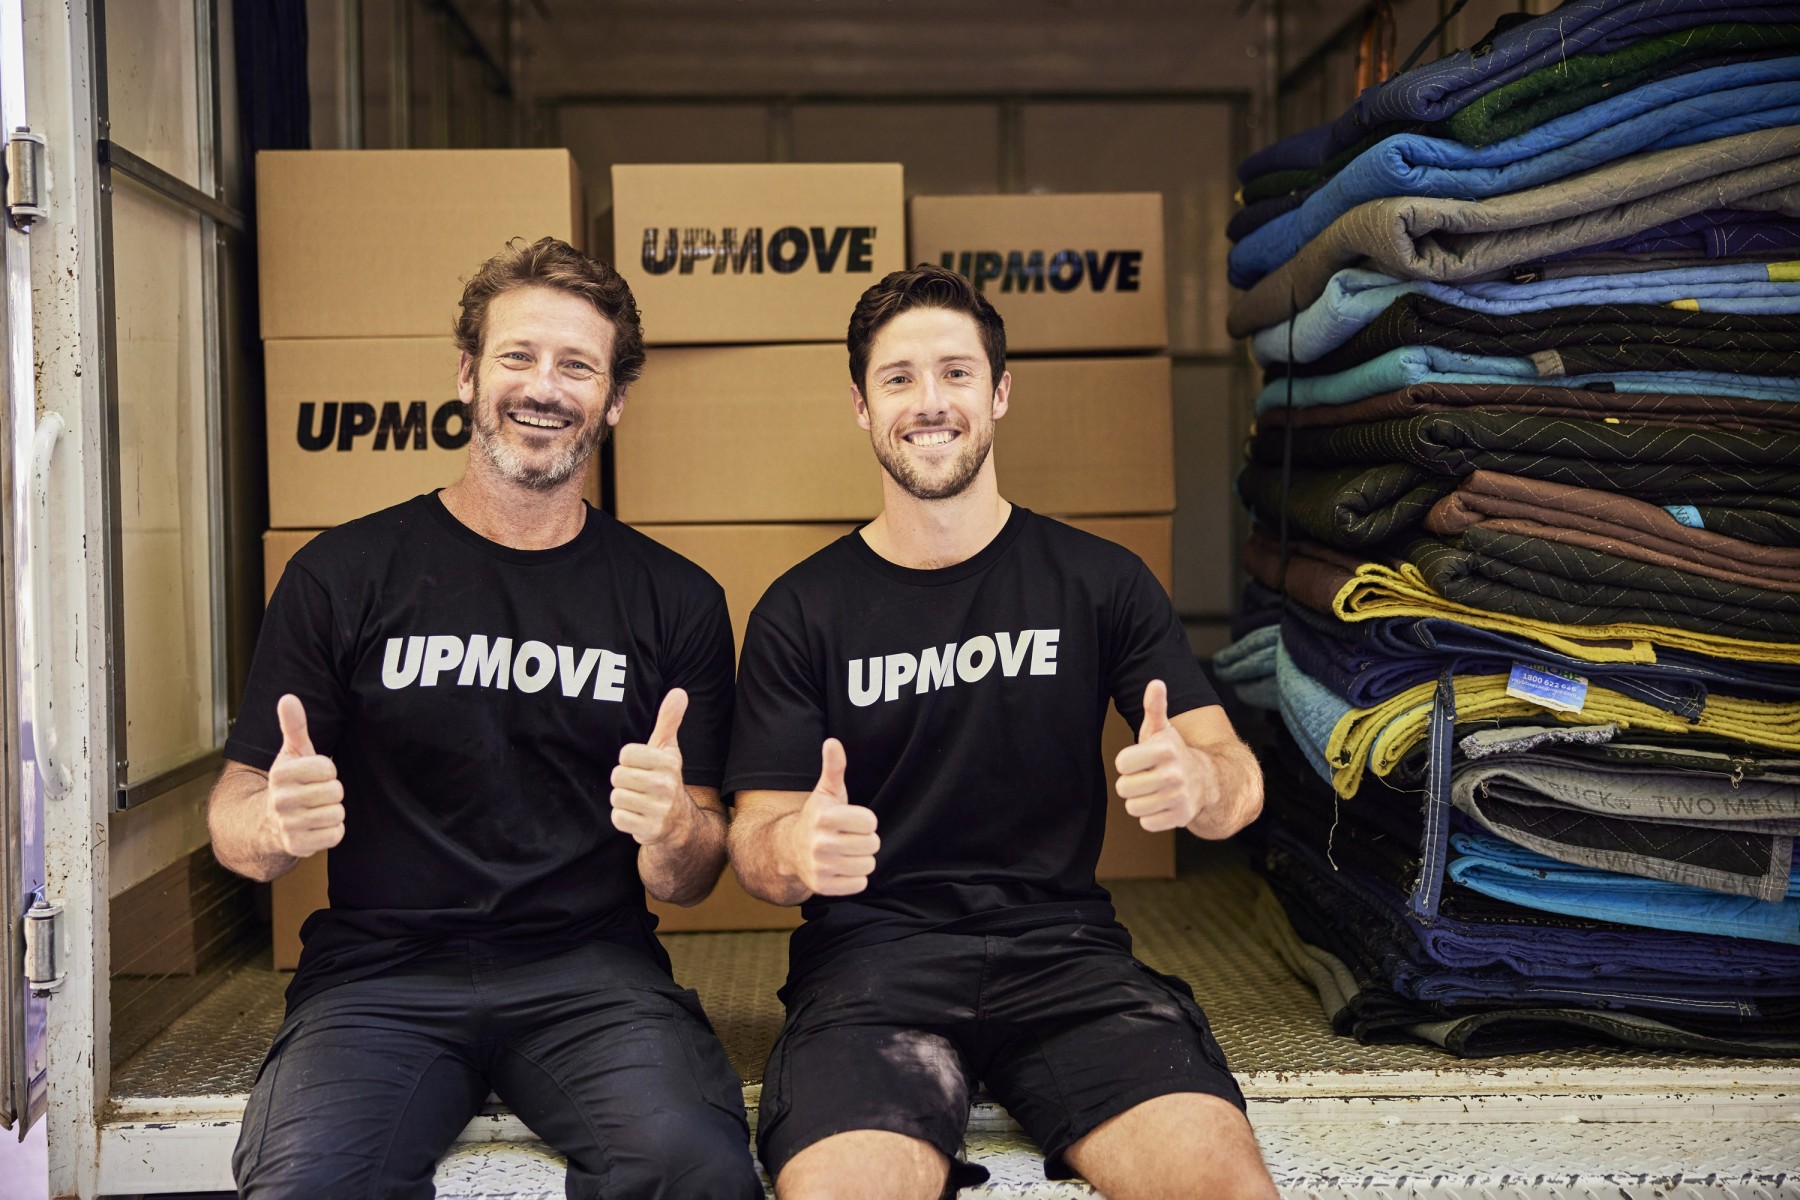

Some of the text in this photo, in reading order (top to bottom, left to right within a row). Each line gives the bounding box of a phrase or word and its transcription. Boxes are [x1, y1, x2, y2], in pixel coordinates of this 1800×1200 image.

[641, 226, 877, 276] UPMOVE
[296, 399, 473, 453] UPMO
[381, 634, 627, 703] UPMOVE
[848, 629, 1061, 708] UPMOVE
[1651, 794, 1717, 816] TWO
[1723, 797, 1787, 817] MEN
